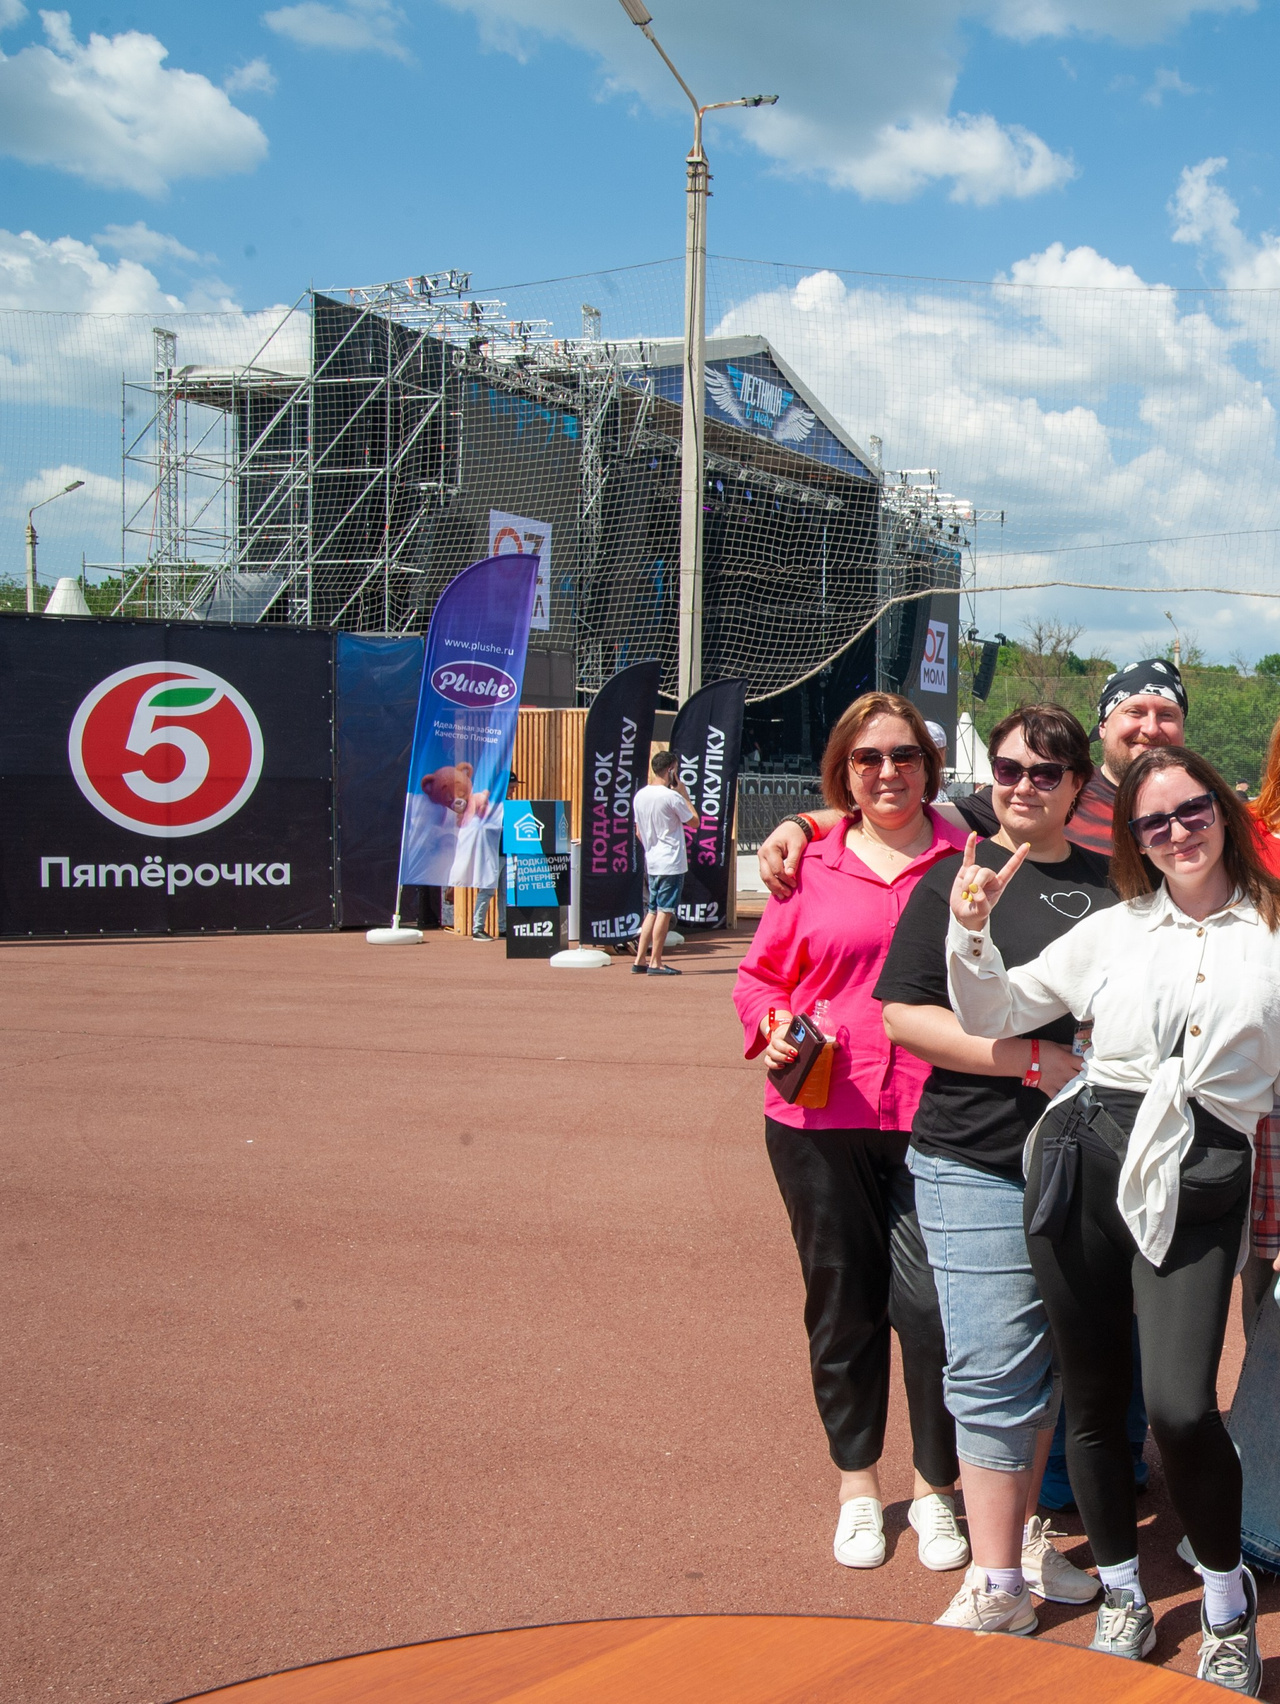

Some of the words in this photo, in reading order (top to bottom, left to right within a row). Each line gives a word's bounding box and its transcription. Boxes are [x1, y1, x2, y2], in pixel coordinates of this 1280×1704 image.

[444, 638, 515, 656] www.plushe.ru
[439, 671, 511, 699] Plushe
[433, 720, 475, 732] Идеальная
[476, 726, 502, 736] забота
[434, 729, 469, 741] Качество
[470, 733, 499, 744] Плюше
[612, 716, 638, 822] ПОКУПКУ
[700, 725, 726, 831] ПОКУПКУ
[592, 751, 614, 874] ПОДАРОК
[517, 855, 571, 867] ПОДКЛЮЧИМ
[612, 839, 628, 874] ЗА
[697, 836, 718, 866] ЗА
[40, 856, 291, 896] Пятёрочка
[517, 862, 568, 876] ДОМАШНИЙ
[518, 872, 561, 883] ИНТЕРНЕТ
[518, 883, 529, 891] ОТ
[531, 881, 557, 890] TELE2
[677, 901, 719, 922] ELE2
[513, 920, 553, 937] TELE2
[591, 912, 641, 938] TELE2
